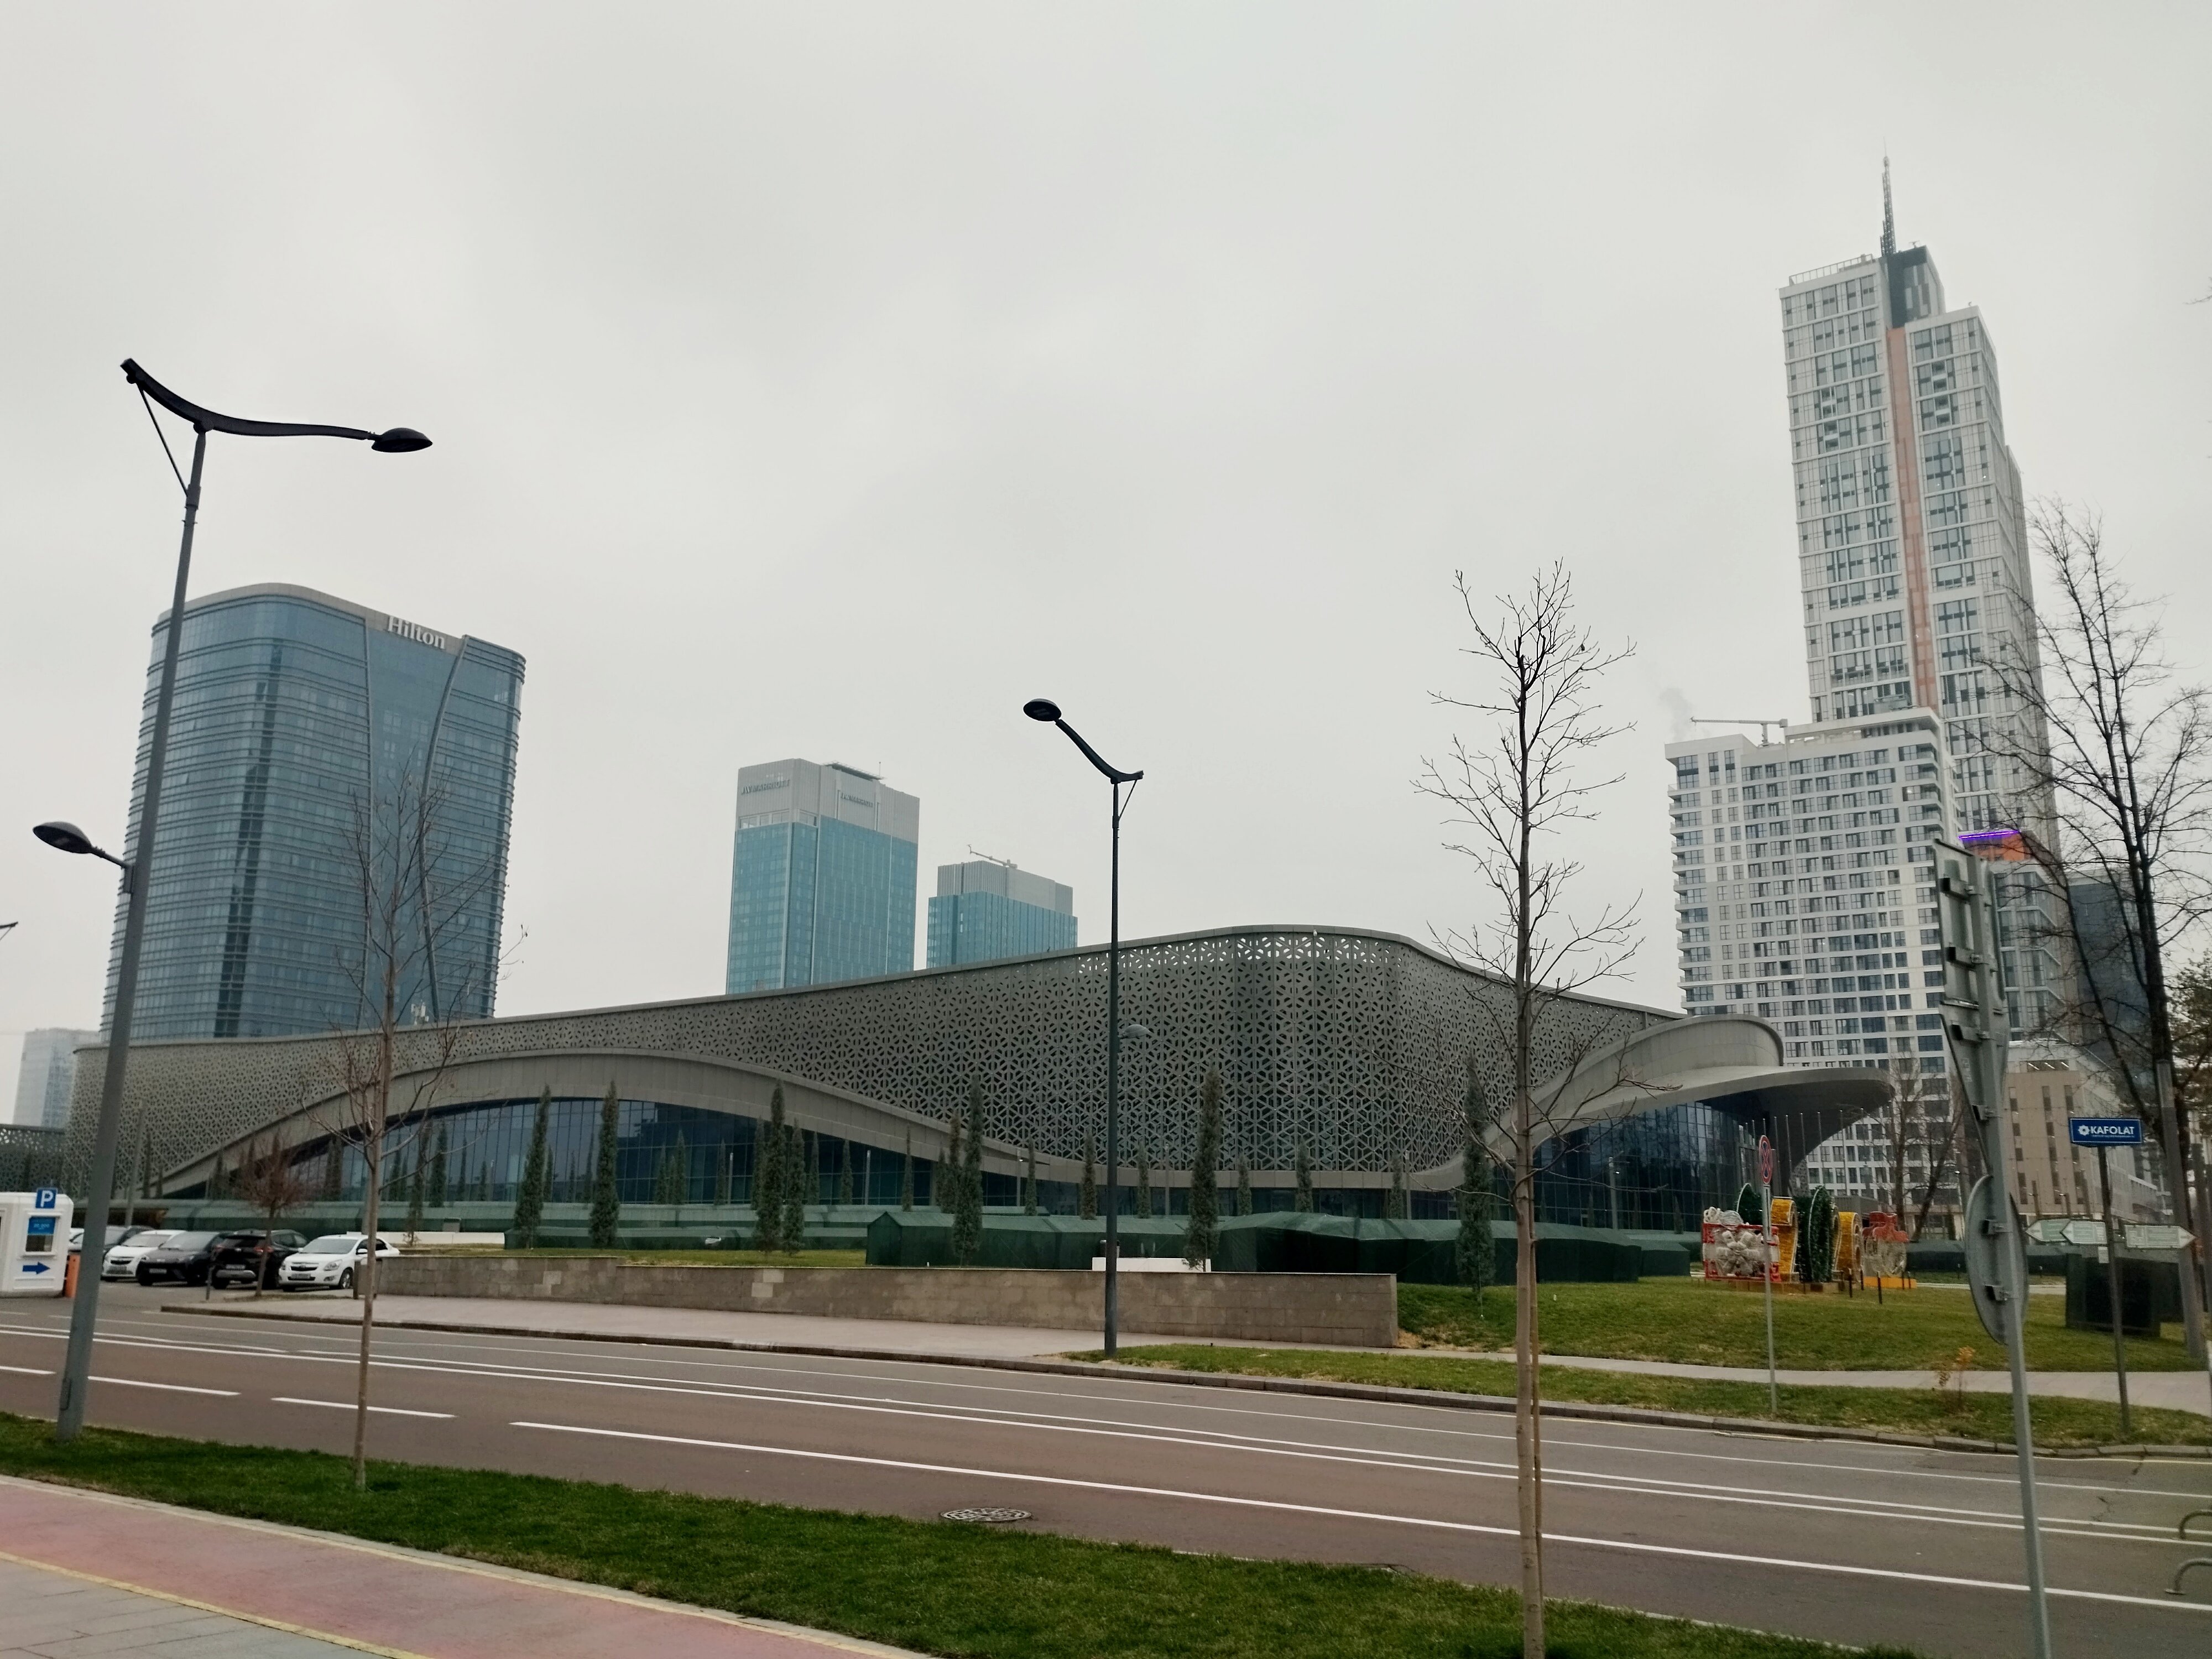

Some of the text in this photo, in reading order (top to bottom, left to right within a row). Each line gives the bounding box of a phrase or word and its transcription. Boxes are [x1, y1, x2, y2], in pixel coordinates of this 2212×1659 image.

[388, 616, 445, 649] Hilton
[2090, 1126, 2135, 1134] KAFOLAT
[40, 1190, 54, 1208] P
